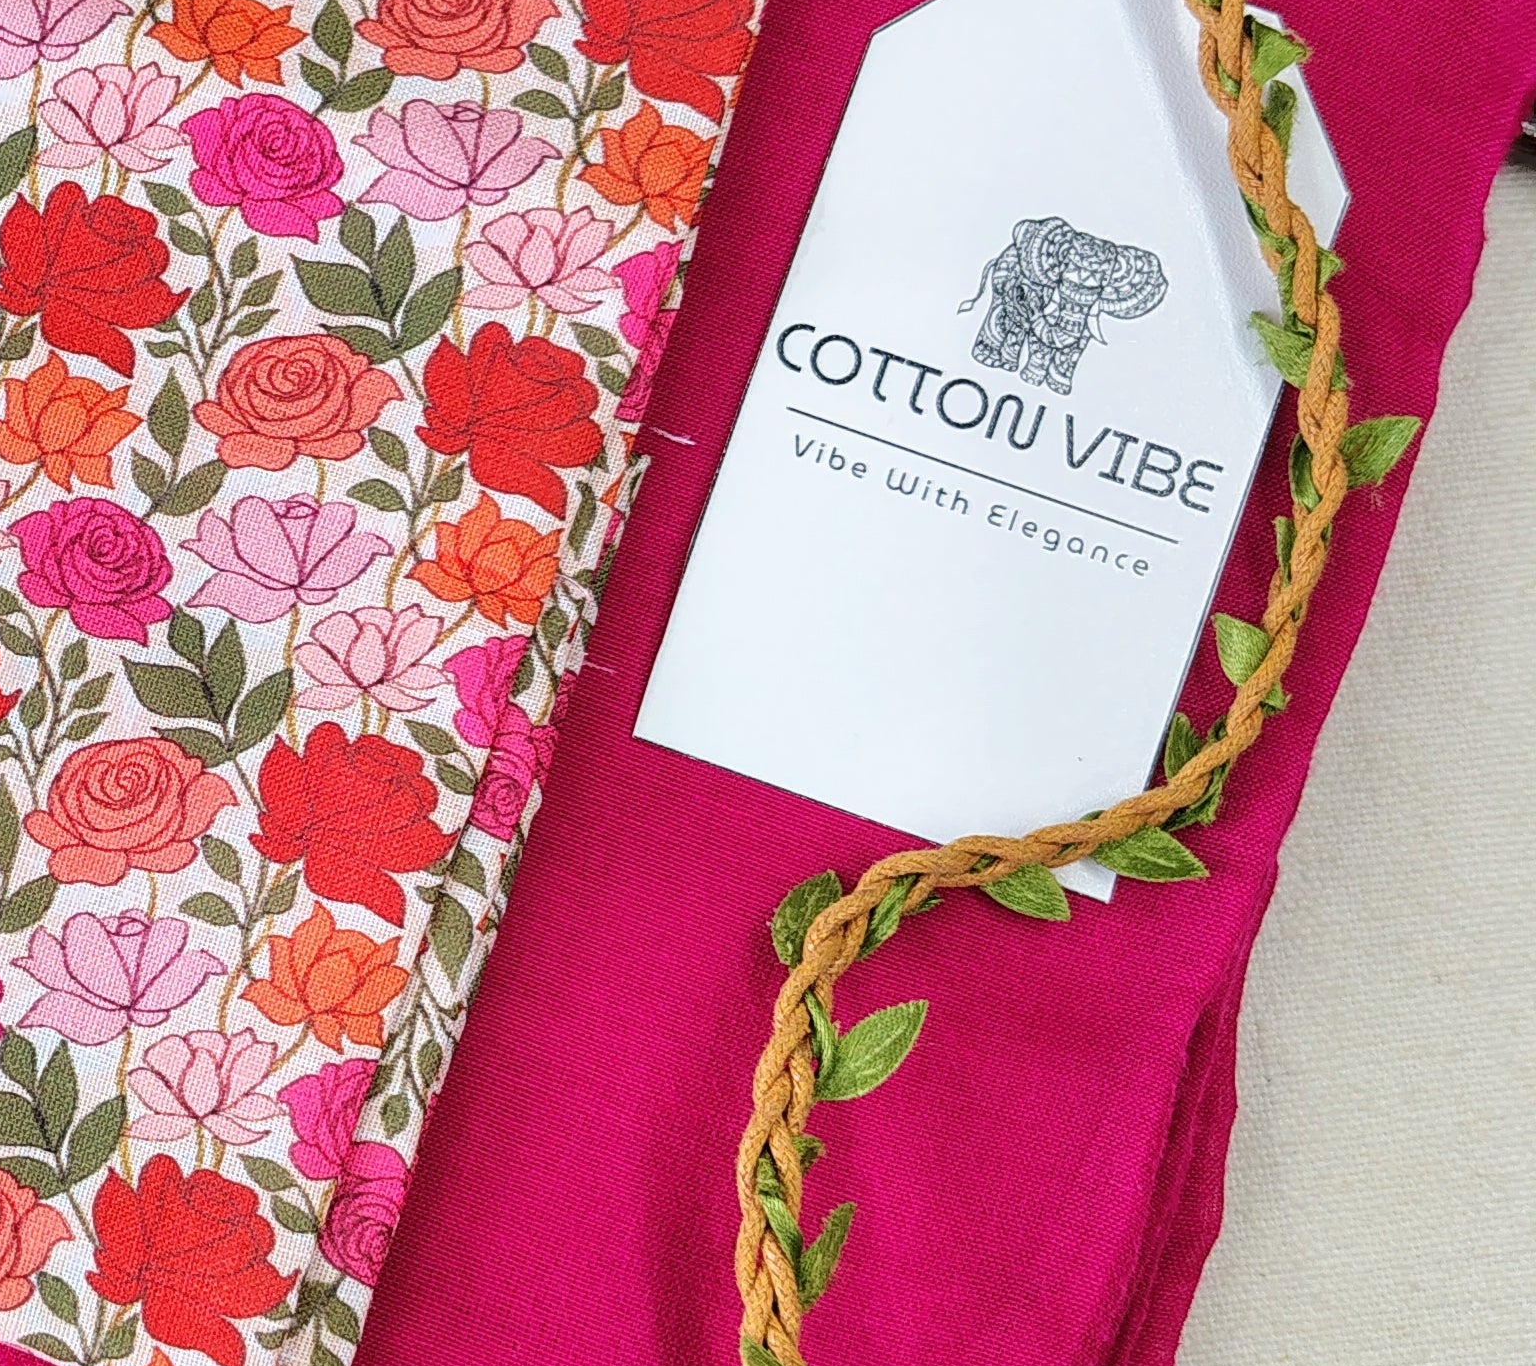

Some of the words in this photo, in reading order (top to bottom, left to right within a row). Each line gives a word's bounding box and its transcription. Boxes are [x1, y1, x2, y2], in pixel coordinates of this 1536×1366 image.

[775, 323, 1048, 451] COTTON
[1065, 413, 1225, 515] VIBE
[793, 433, 868, 479] Vibe
[885, 467, 969, 515] With
[987, 504, 1150, 578] Elegance
